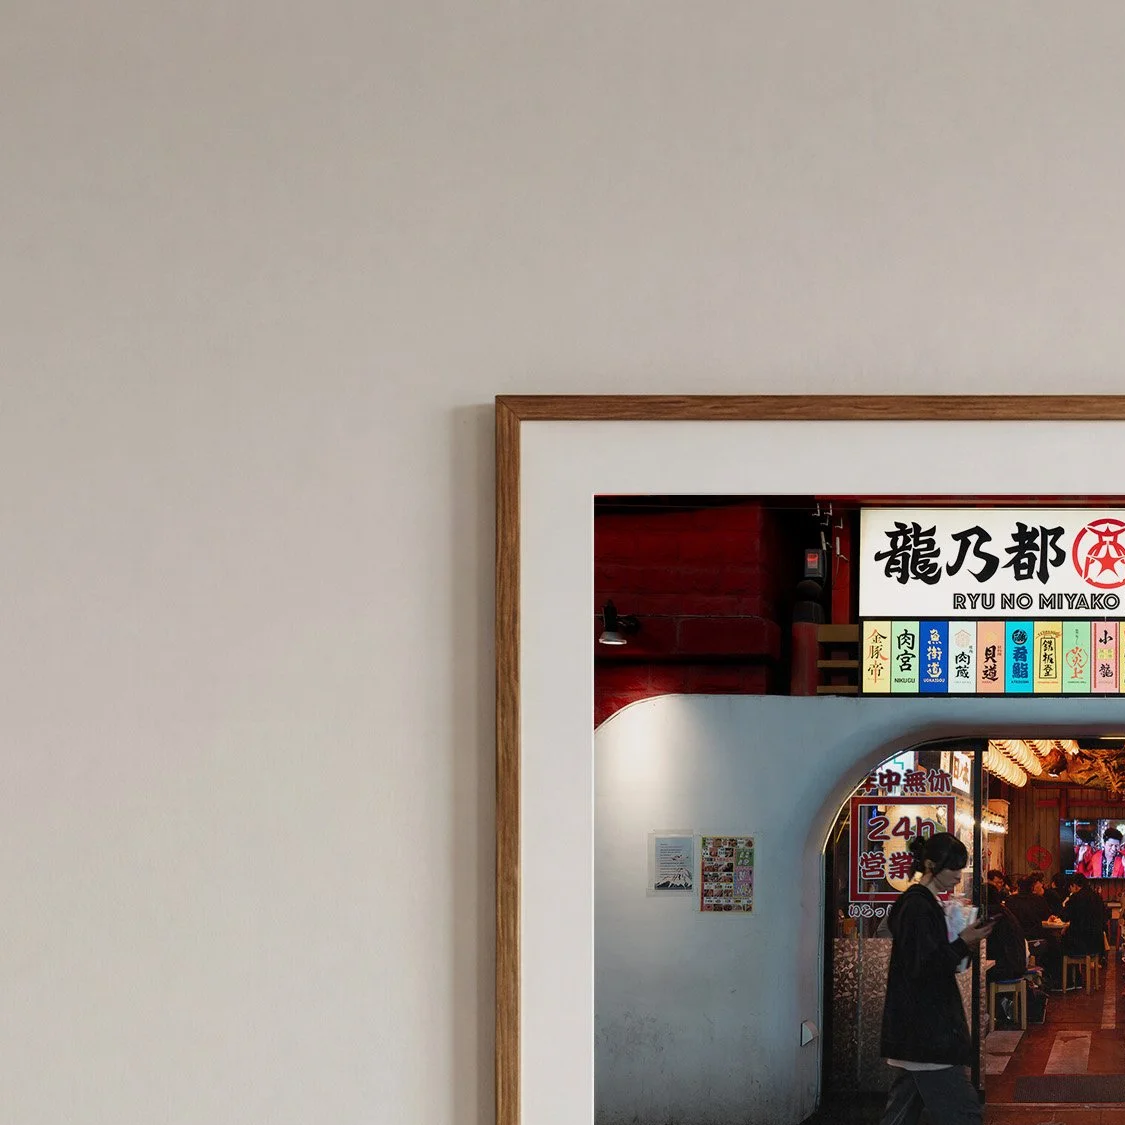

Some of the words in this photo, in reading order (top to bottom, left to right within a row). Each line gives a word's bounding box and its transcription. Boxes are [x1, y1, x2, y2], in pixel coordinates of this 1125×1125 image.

[874, 521, 1067, 586] 龍乃都
[953, 592, 996, 611] RYU
[1000, 592, 1034, 611] NO
[1038, 592, 1121, 611] MIYAKO
[895, 628, 916, 672] 肉宮
[868, 816, 935, 841] 24h
[848, 904, 893, 918] いらっ
